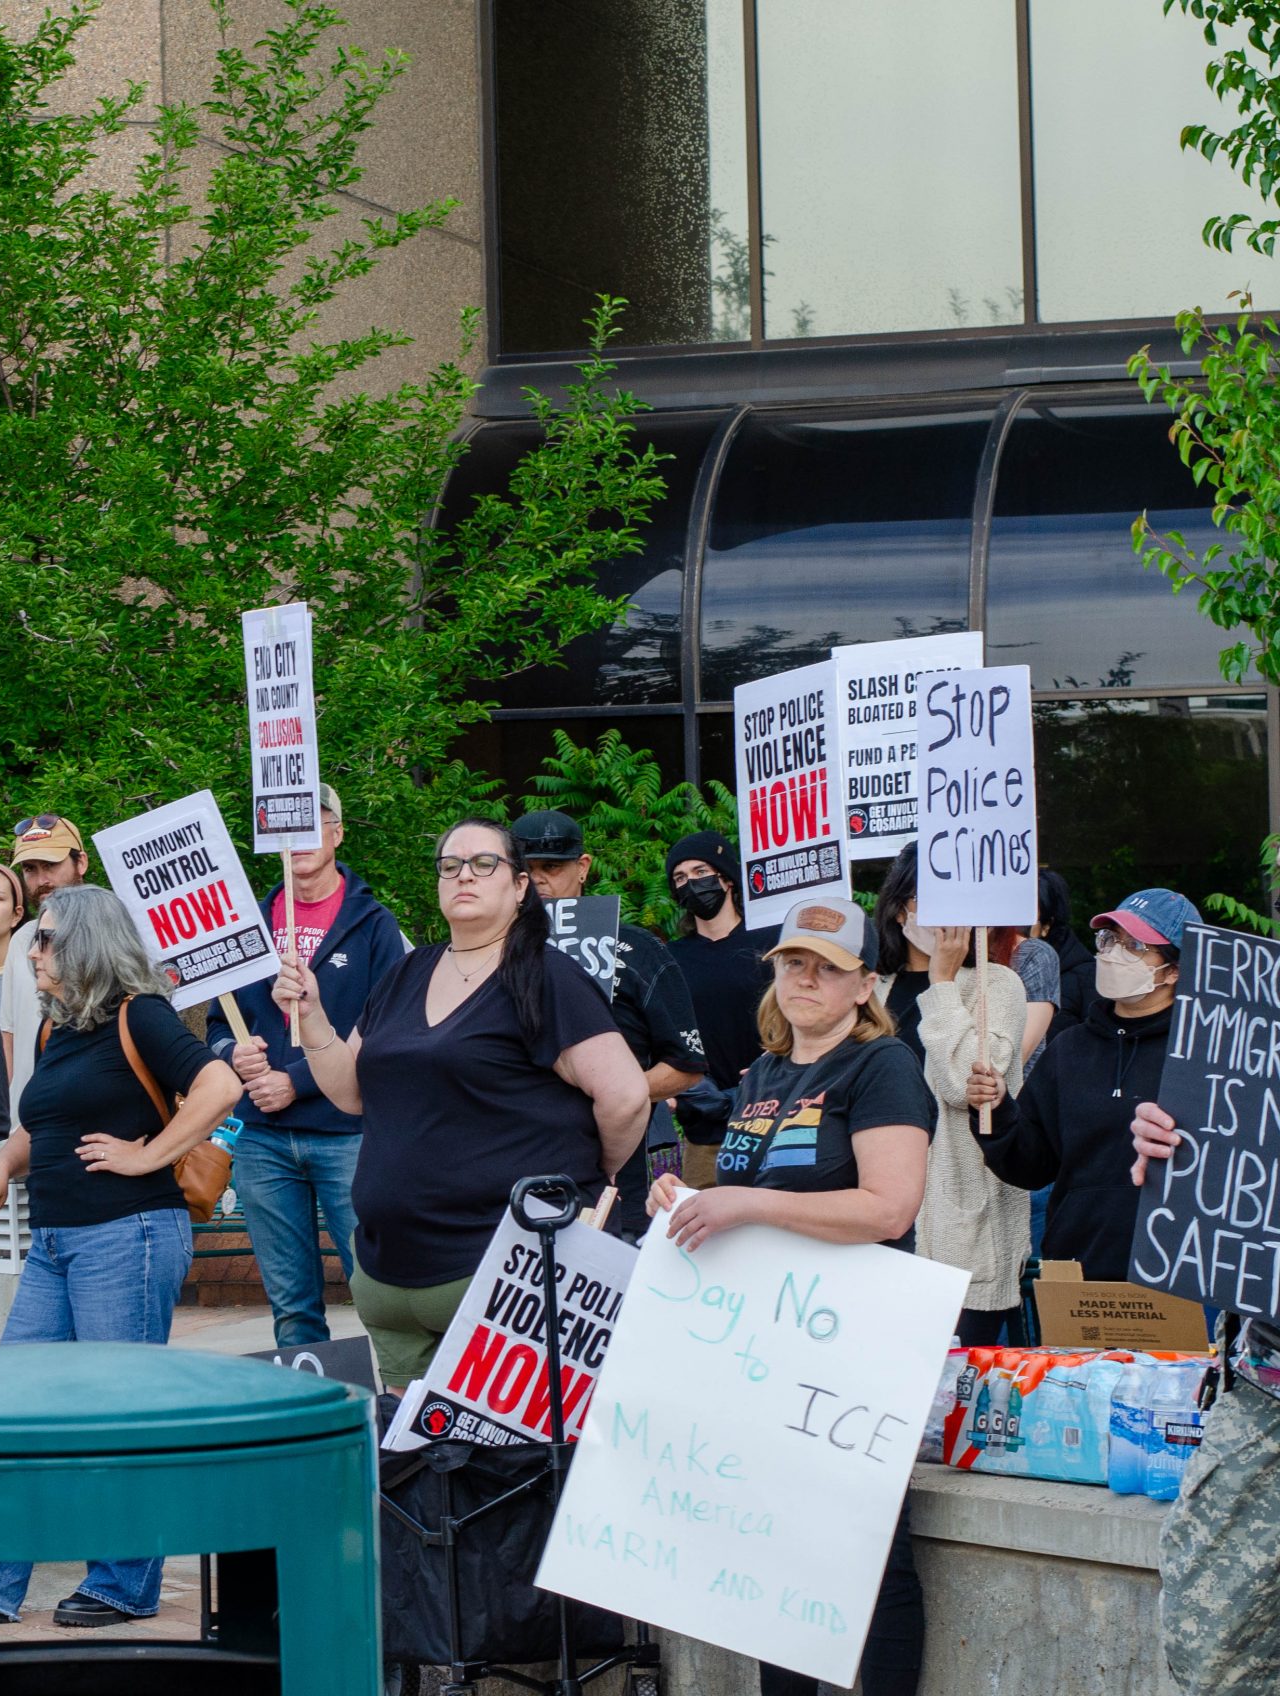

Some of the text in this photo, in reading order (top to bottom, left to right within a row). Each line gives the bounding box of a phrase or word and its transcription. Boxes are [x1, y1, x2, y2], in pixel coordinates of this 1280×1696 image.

[254, 640, 297, 681] END CITY
[256, 683, 299, 713] AND COUNTY
[848, 674, 898, 701] SLASH
[258, 717, 303, 749] COLLUSION
[744, 690, 824, 742] STOP POLICE
[848, 702, 903, 725] BLOATED
[927, 680, 1010, 752] Stop
[260, 753, 305, 788] WITH ICE!
[746, 724, 826, 784] VIOLENCE
[848, 747, 882, 767] FUND
[888, 746, 896, 763] A
[848, 771, 911, 801] BUDGET
[927, 767, 1023, 818] Police
[749, 767, 831, 854] NOW!
[869, 805, 886, 818] GET
[122, 821, 204, 870] COMMUNITY
[929, 828, 1031, 883] Crimes
[133, 847, 219, 900] CONTROL
[147, 880, 239, 950] NOW!
[177, 955, 191, 969] GET
[191, 942, 227, 961] INVOLVED
[227, 938, 238, 951] @
[182, 948, 244, 981] COSAARPR.ORG
[546, 936, 617, 979] ESS
[1199, 1074, 1245, 1137] IS
[564, 1272, 623, 1324] POLI
[648, 1246, 839, 1344] Say No
[1070, 1310, 1167, 1320] LESS MATERIAL
[1079, 1300, 1154, 1310] MADE WITH
[734, 1335, 769, 1382] to
[447, 1324, 598, 1444] NOW!
[455, 1411, 476, 1432] GET
[784, 1383, 909, 1464] ICE
[977, 1414, 987, 1429] G
[992, 1413, 1002, 1431] G
[1007, 1417, 1016, 1432] G
[565, 1513, 678, 1580] WARM
[710, 1568, 764, 1601] AND
